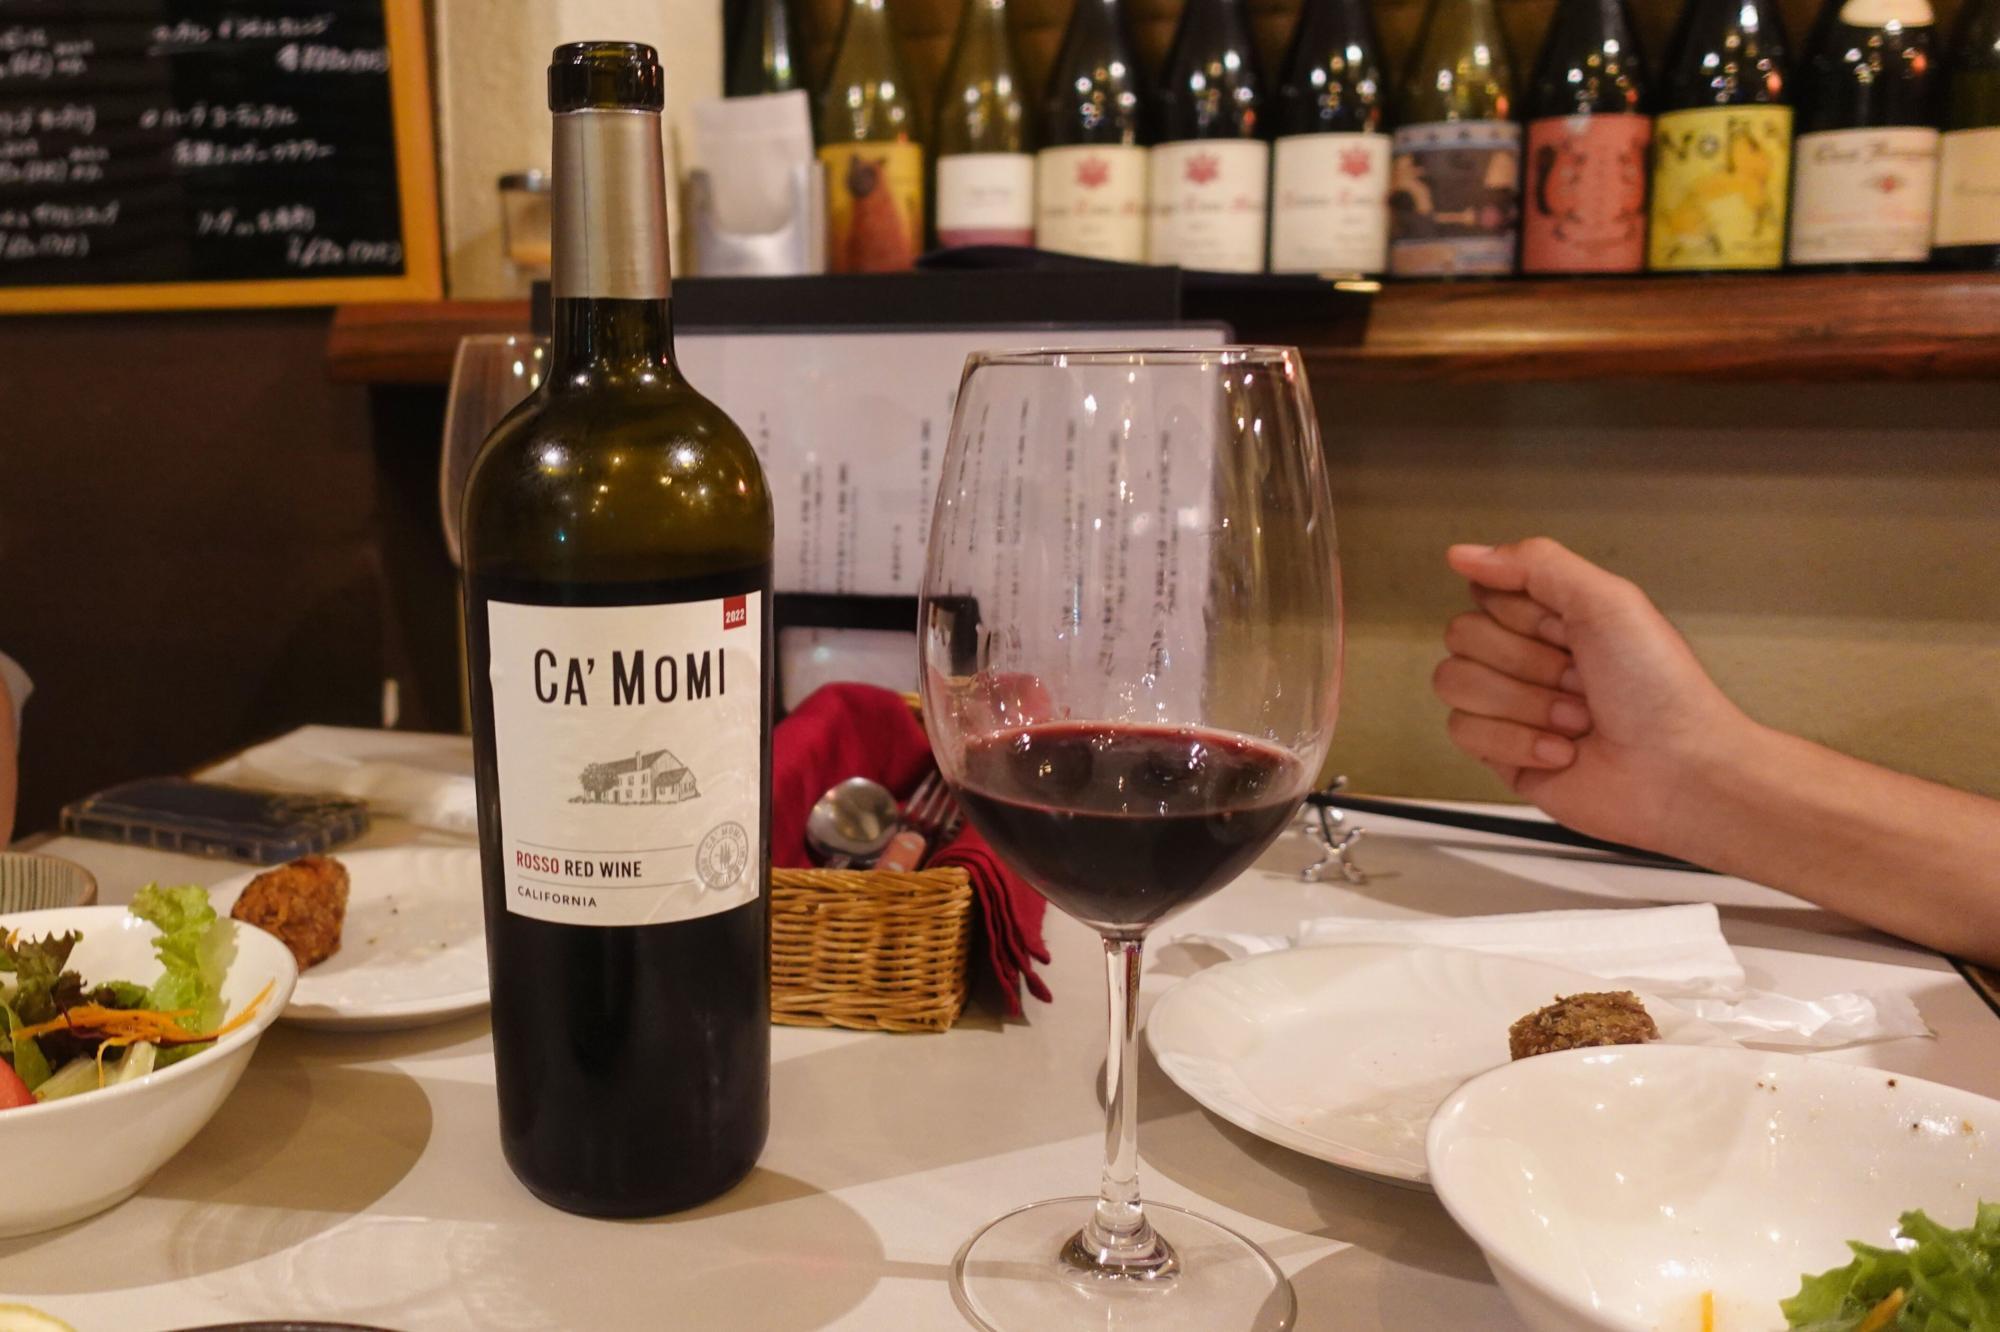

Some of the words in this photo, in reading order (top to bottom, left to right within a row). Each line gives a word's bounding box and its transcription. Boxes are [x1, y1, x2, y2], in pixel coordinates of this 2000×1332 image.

[725, 608, 745, 624] 2022
[533, 647, 596, 707] CA'
[611, 647, 726, 707] MOMI
[516, 849, 560, 875] ROSSO
[564, 858, 594, 878] RED
[599, 860, 642, 879] WINE
[517, 885, 597, 908] CALIFORNIA
